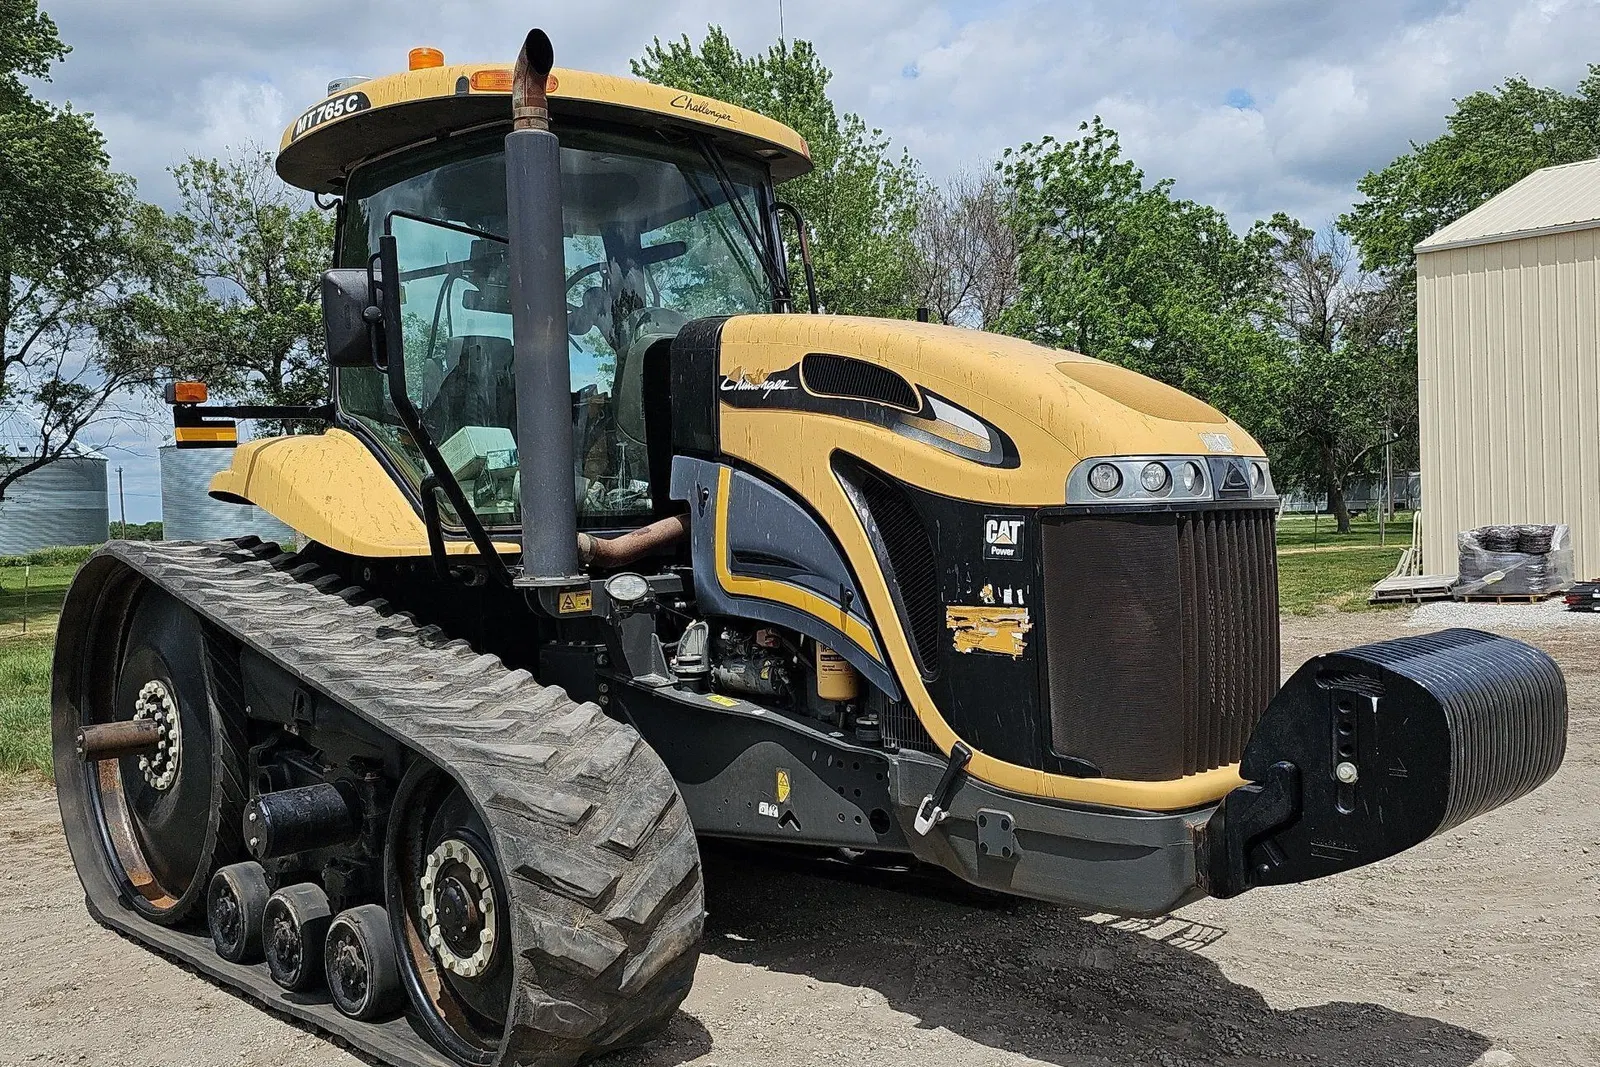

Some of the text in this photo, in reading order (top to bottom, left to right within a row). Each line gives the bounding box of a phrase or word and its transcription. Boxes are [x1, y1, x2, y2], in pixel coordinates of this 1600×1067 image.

[296, 94, 359, 136] MT765C
[670, 94, 738, 124] Challenger
[985, 519, 1020, 545] CAT
[991, 546, 1015, 556] Power
